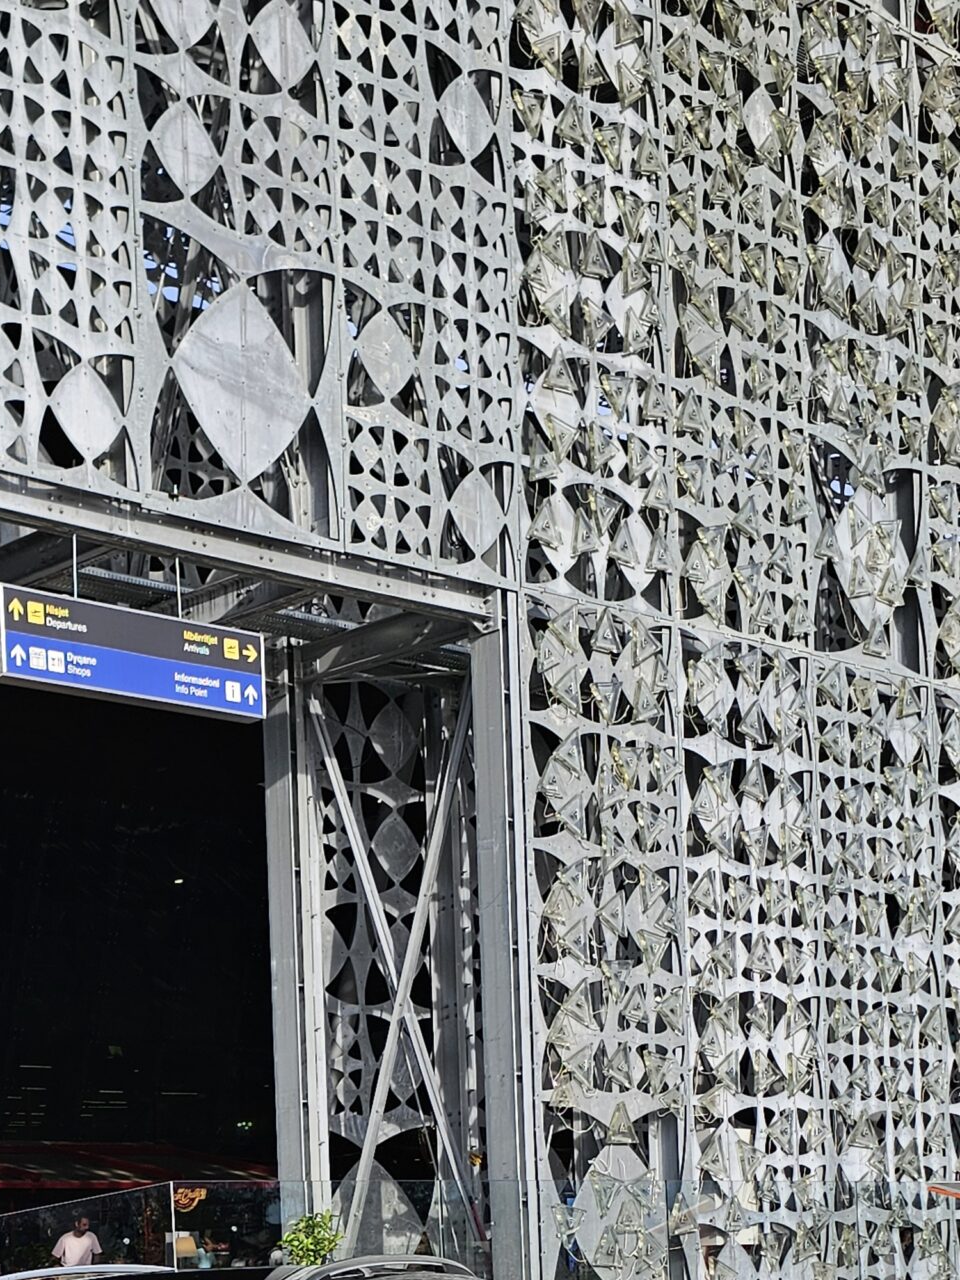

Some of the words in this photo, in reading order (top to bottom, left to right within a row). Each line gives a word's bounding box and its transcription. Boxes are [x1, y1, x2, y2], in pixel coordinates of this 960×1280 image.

[46, 616, 88, 632] Departures
[183, 642, 210, 655] Arrivals
[67, 651, 97, 666] Dyqane
[67, 664, 91, 678] Shops
[175, 684, 189, 695] Info
[190, 686, 208, 698] Point
